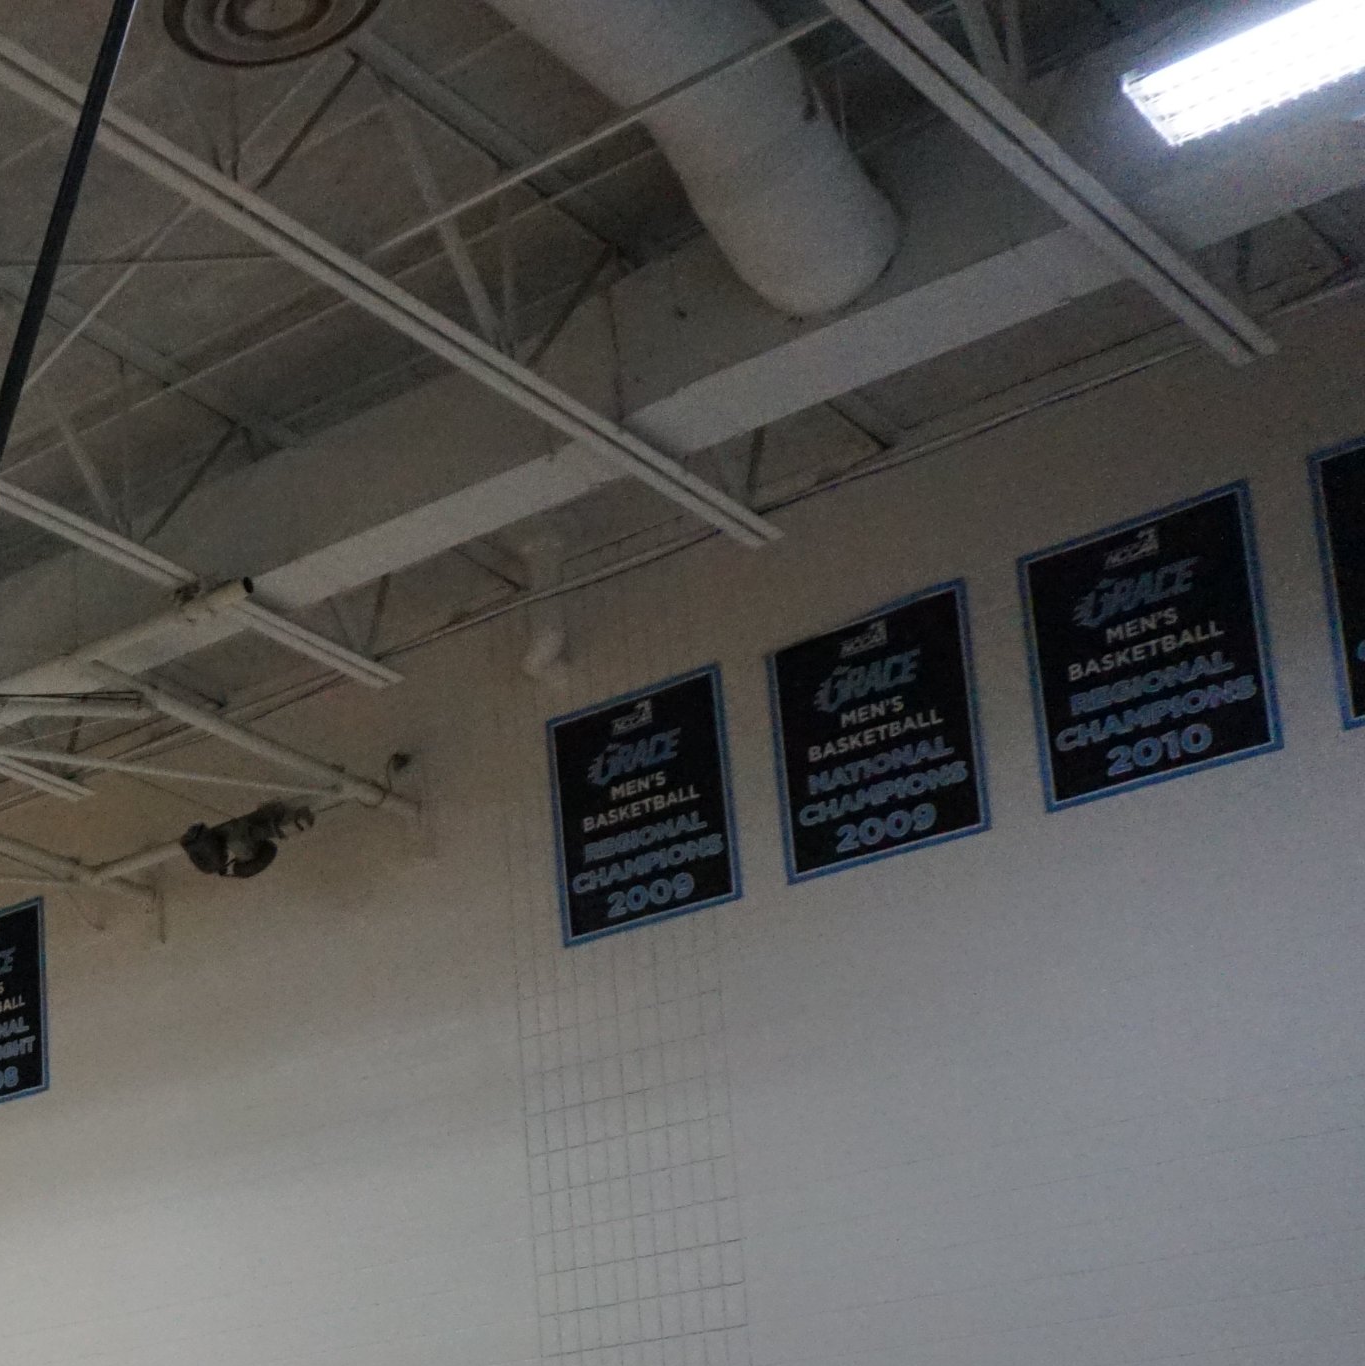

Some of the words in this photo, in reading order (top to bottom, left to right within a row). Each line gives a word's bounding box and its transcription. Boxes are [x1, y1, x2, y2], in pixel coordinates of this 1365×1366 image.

[1066, 616, 1226, 683] BASKETBALL
[1104, 604, 1179, 645] MEN'S
[839, 692, 904, 731] MEN'S
[1068, 647, 1234, 718] REGIONAL
[807, 703, 943, 765] BASKETBALL
[1054, 672, 1257, 754] CHAMPIONS
[806, 730, 955, 798] NATIONAL
[1105, 719, 1214, 778] 2010
[581, 781, 701, 834] BASKETBALL
[609, 769, 666, 802] MEN'S
[797, 756, 968, 830] CHAMPIONS
[581, 807, 708, 864] REGIONAL
[833, 798, 938, 854] 2009
[571, 831, 725, 896] CHAMPIONS
[605, 869, 695, 919] 2009
